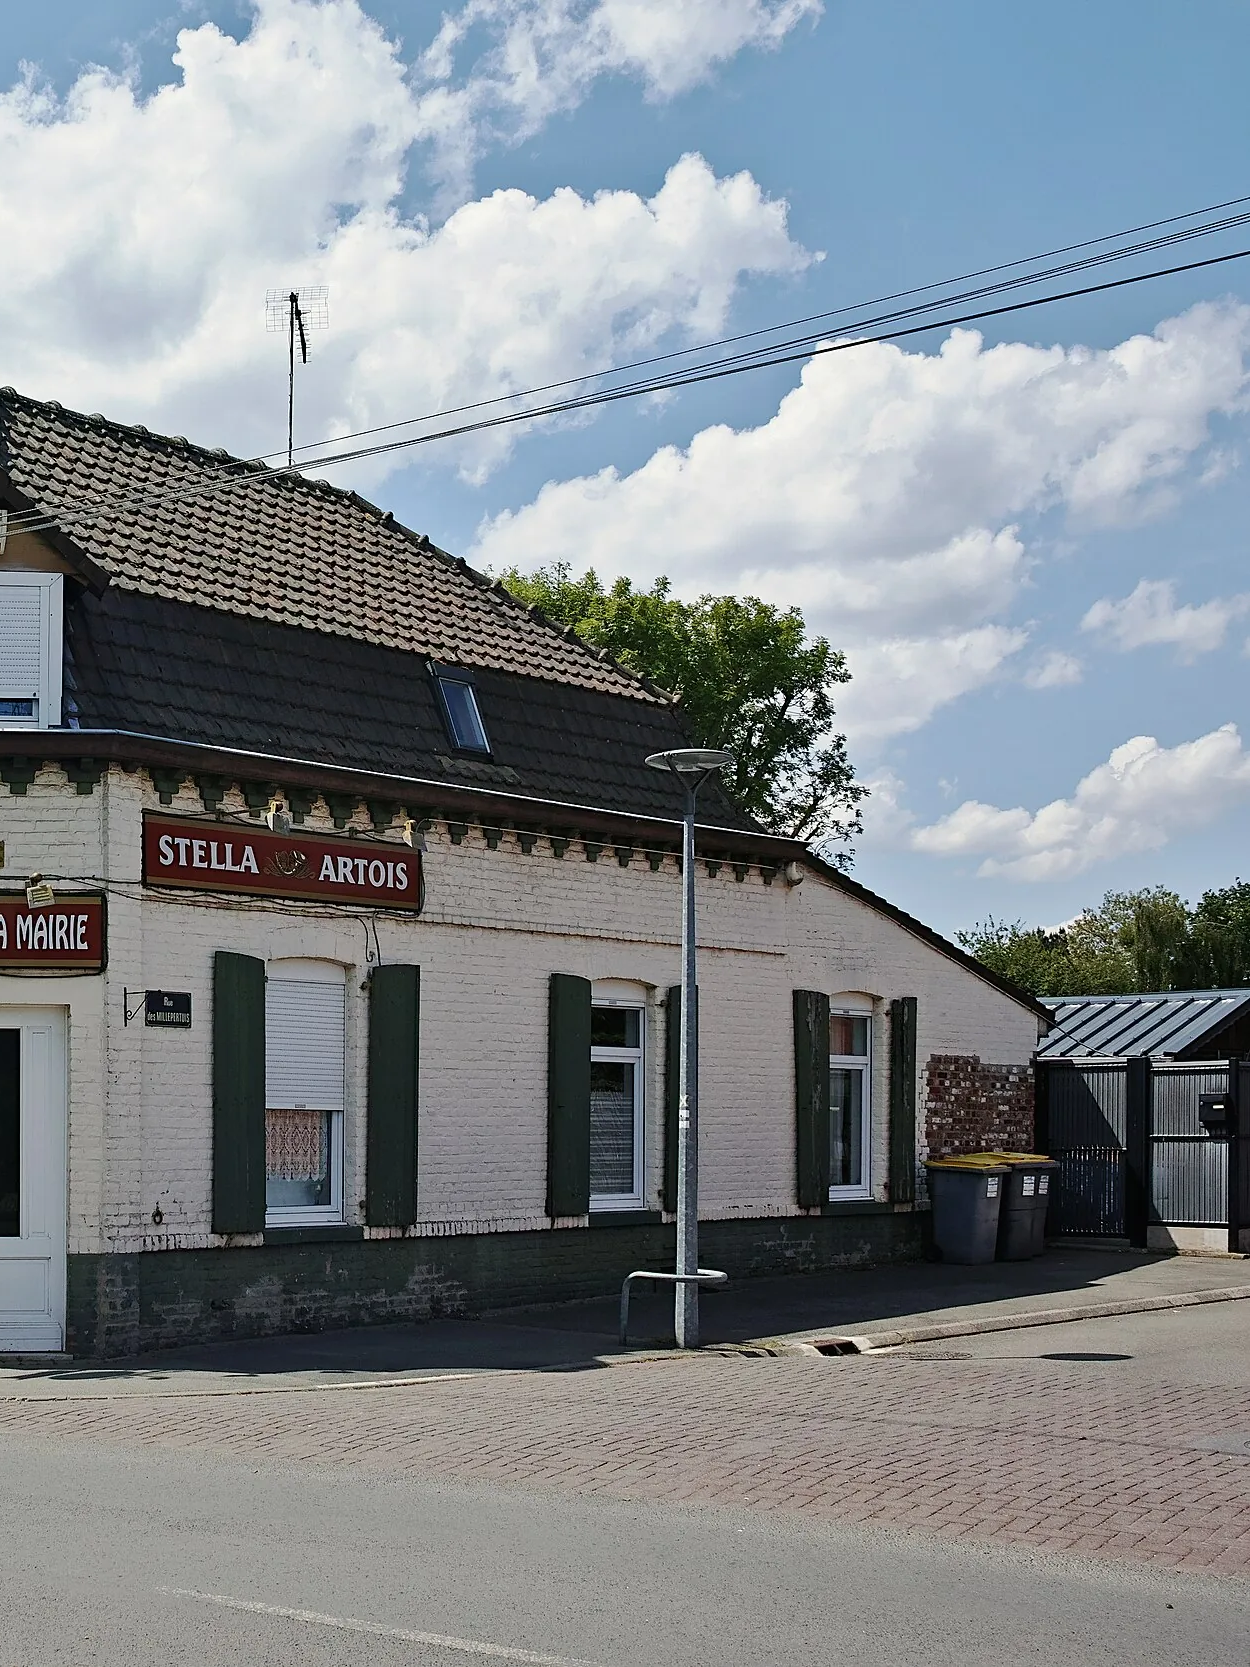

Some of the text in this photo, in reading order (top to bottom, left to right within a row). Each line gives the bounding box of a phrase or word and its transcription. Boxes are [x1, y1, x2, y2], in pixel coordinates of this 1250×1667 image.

[158, 834, 409, 891] STELLA ARTOIS
[16, 913, 90, 951] MAIRIE
[163, 996, 174, 1007] Rue
[147, 1011, 190, 1023] des MILLEPERTUIS
